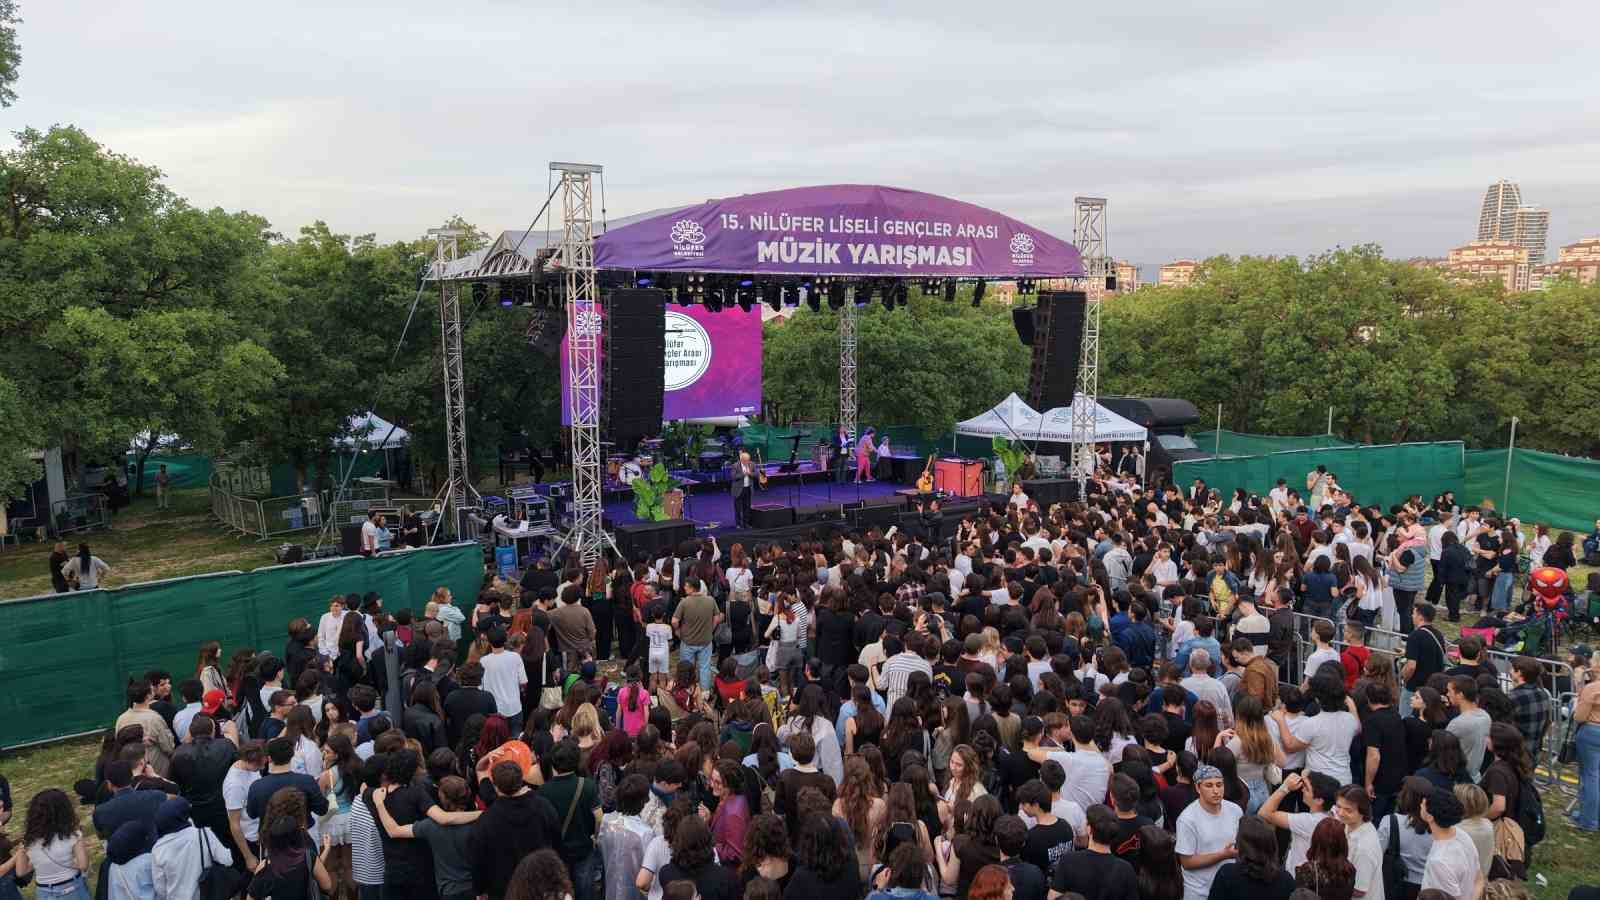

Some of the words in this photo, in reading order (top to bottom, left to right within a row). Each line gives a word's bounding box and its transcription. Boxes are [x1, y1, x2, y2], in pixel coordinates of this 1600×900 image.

[720, 214, 744, 230] 15.
[750, 212, 824, 233] NİLÜFER
[829, 215, 878, 235] LİSELİ
[883, 220, 952, 240] GENÇLER
[955, 224, 998, 239] ARASI
[757, 236, 841, 264] MÜZİK
[847, 243, 972, 269] YARIŞMASI
